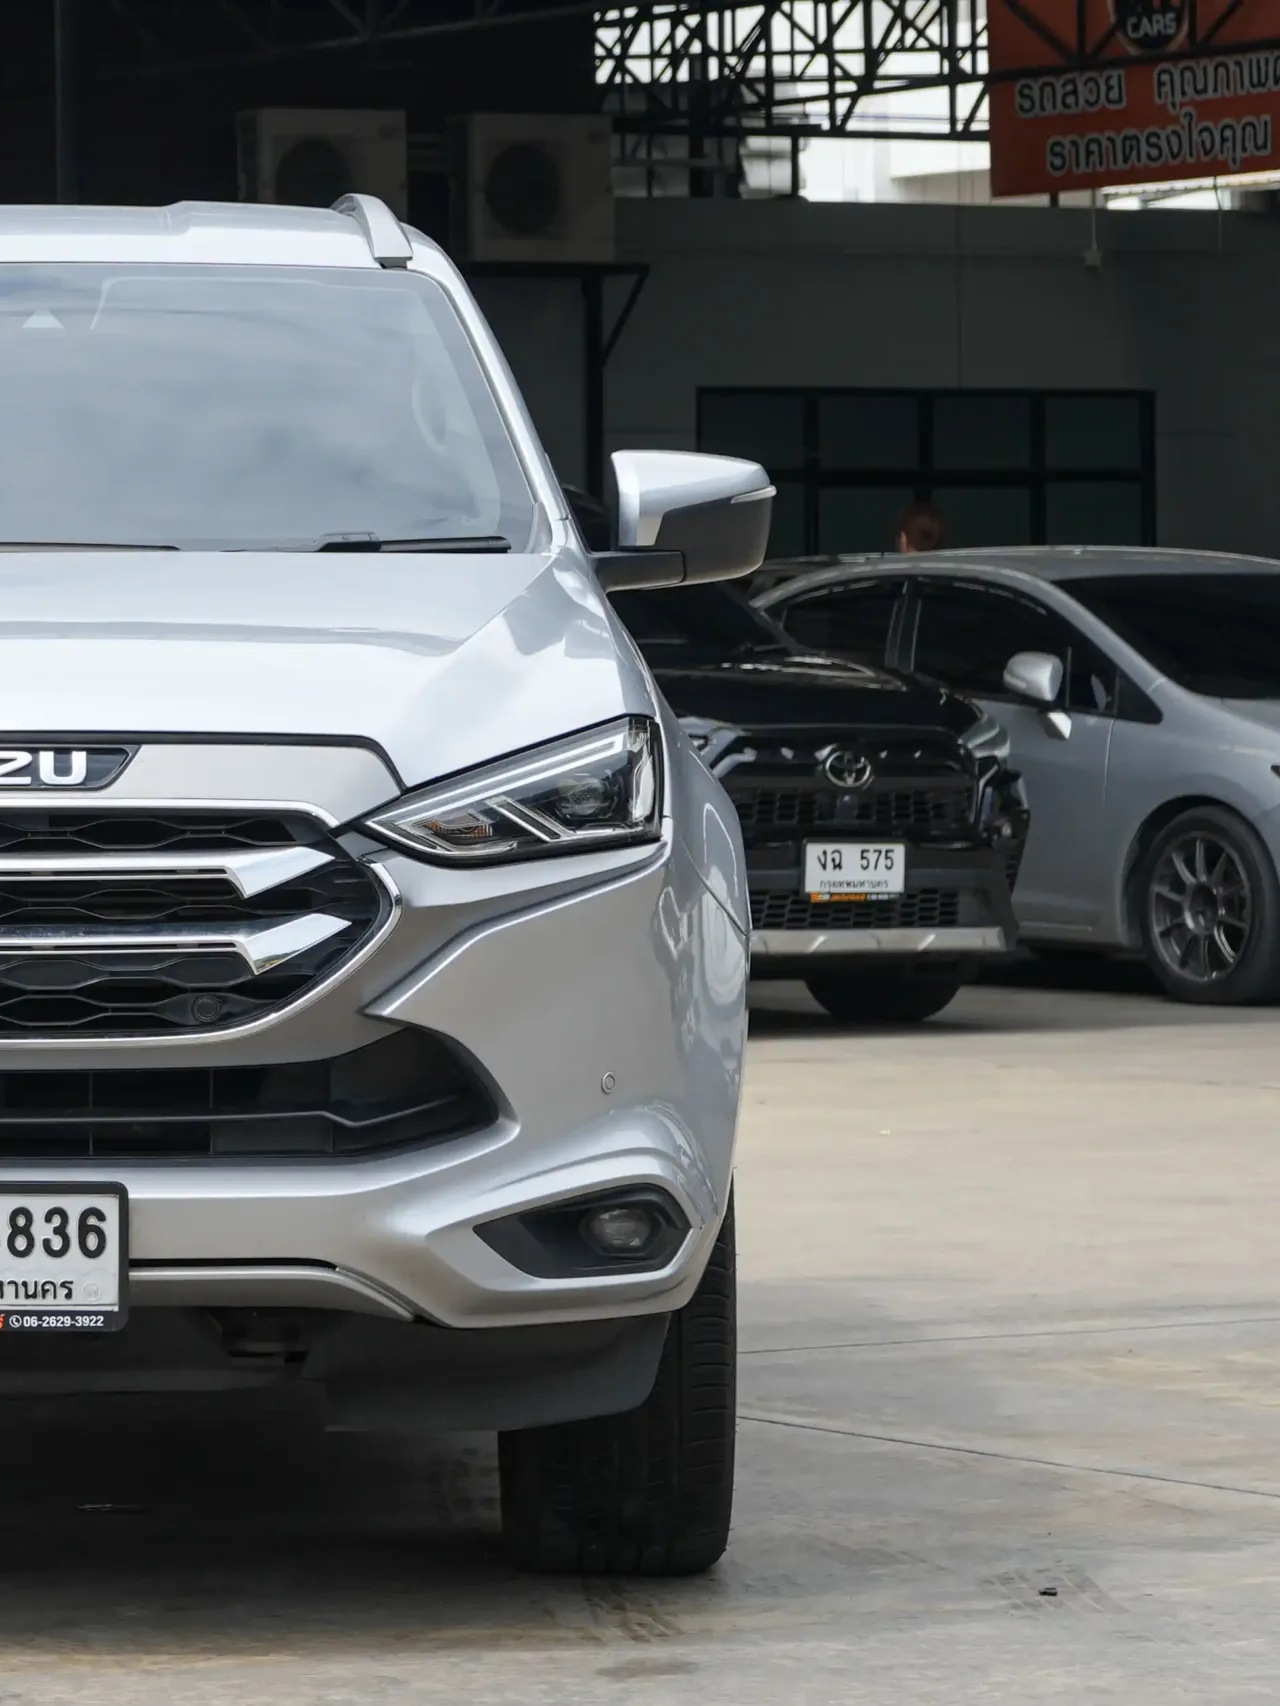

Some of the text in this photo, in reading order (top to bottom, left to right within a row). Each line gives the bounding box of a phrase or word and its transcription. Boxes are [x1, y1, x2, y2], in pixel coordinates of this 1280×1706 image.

[1126, 13, 1177, 39] CARS
[1017, 69, 1126, 116] รถสวย
[1048, 108, 1270, 174] ราคาตรงใจคุณ
[860, 849, 895, 871] 575
[23, 1314, 105, 1328] 06-2629-3922
